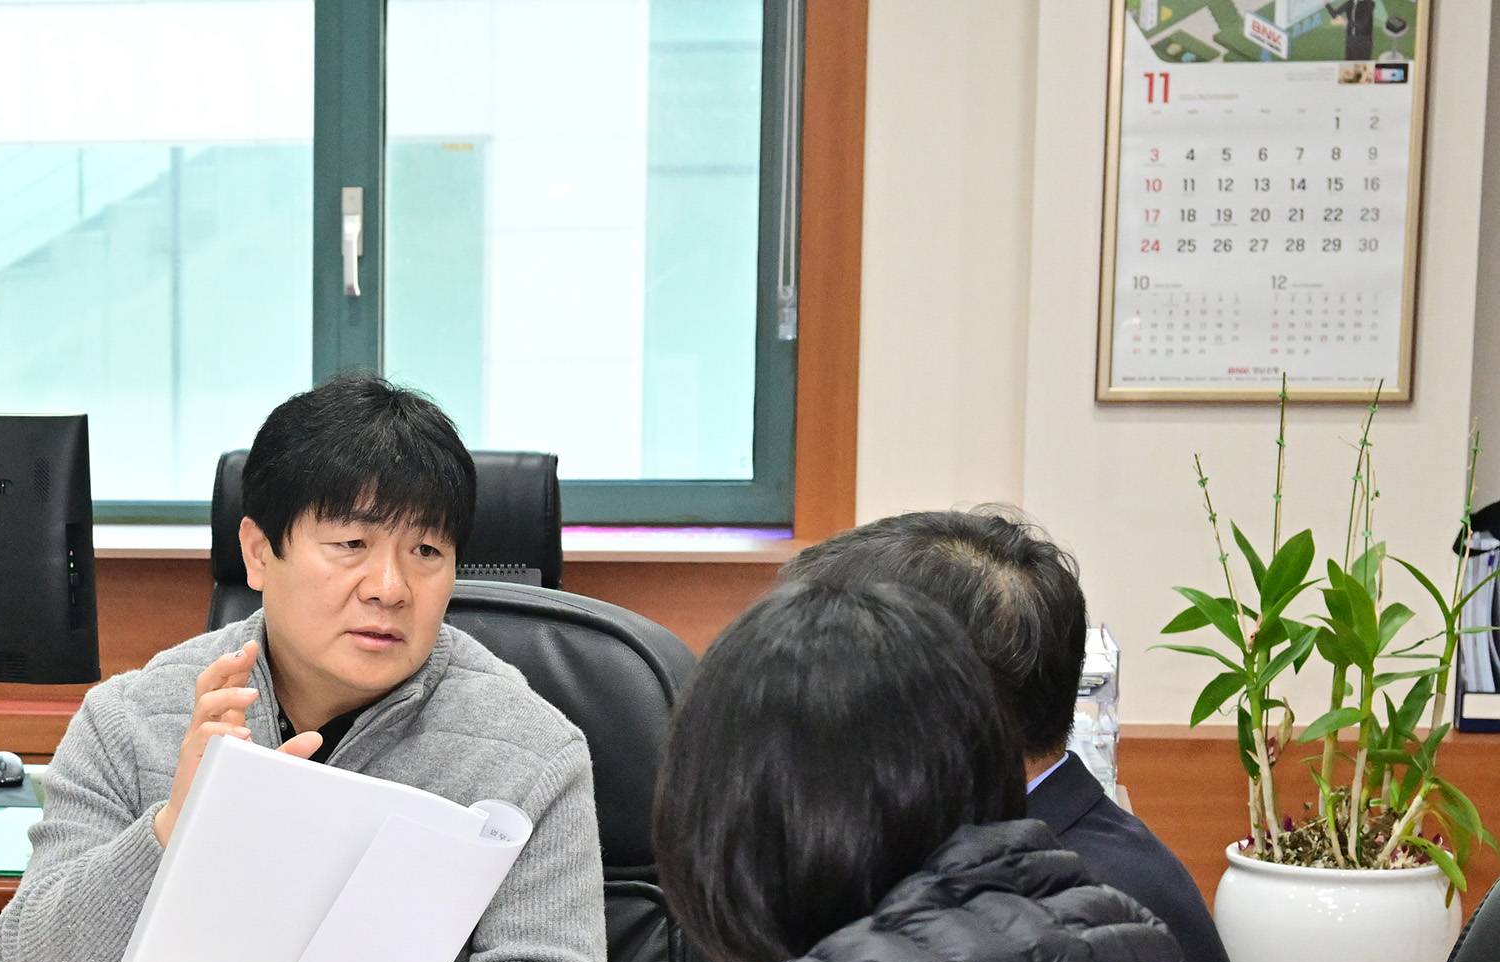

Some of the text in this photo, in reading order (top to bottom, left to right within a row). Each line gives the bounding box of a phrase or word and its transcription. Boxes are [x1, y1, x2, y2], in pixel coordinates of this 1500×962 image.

[1144, 72, 1170, 103] 11
[1334, 115, 1381, 131] 1 2
[1149, 146, 1379, 163] 3 4 5 6 7 8 9
[1145, 176, 1381, 193] 10 11 12 13 14 15 16
[1144, 207, 1381, 223] 17 18 19 20 21 22 23
[1140, 237, 1379, 253] 24 25 26 27 28 29 30
[1133, 276, 1150, 290] 10
[1271, 275, 1288, 290] 12
